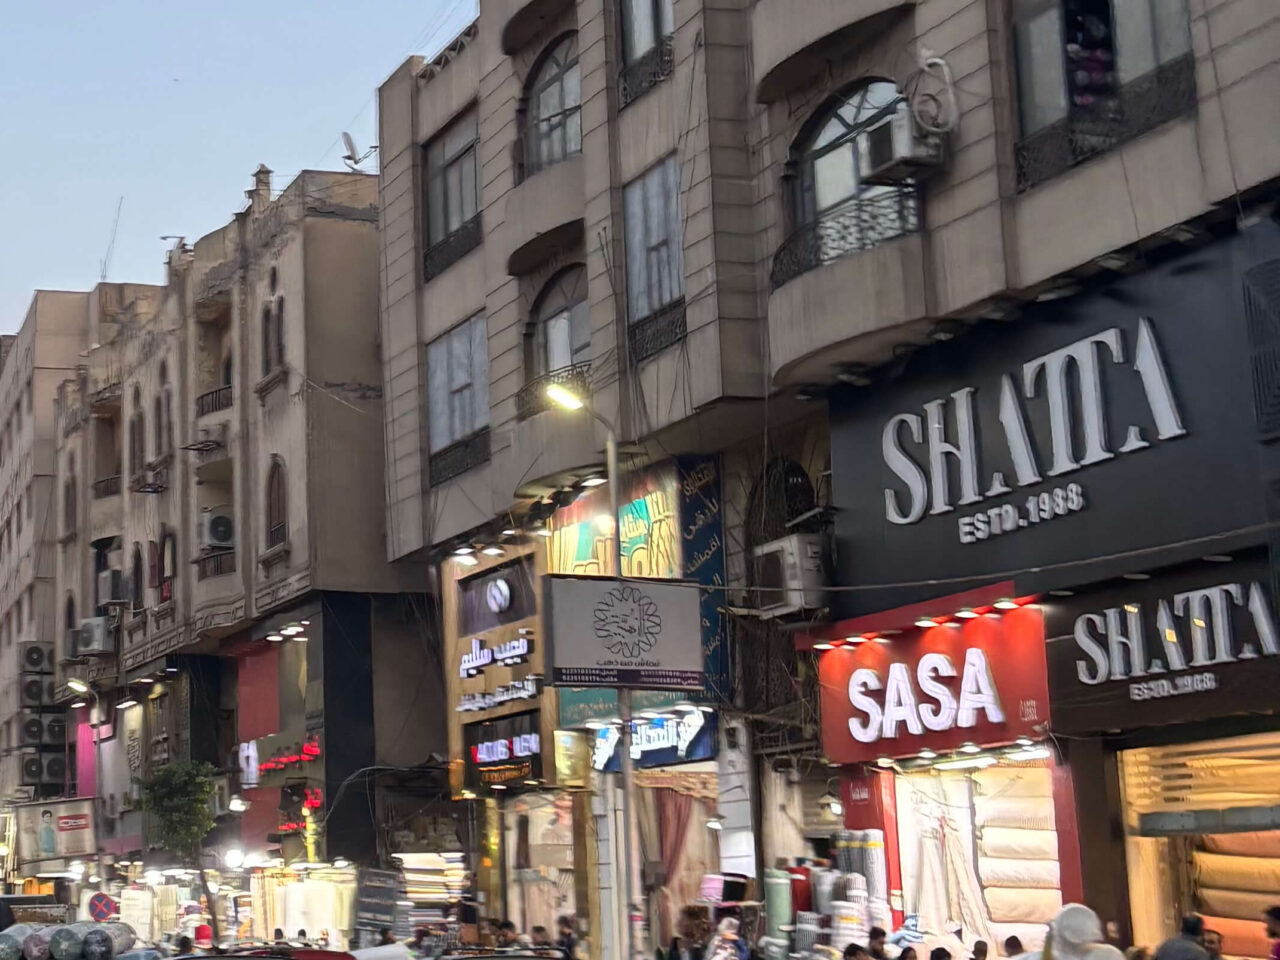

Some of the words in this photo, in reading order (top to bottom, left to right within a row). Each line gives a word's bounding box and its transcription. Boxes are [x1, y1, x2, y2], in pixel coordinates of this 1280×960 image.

[881, 315, 1187, 525] SHATTA
[1073, 581, 1280, 685] SHATTA
[848, 647, 1006, 743] SASA
